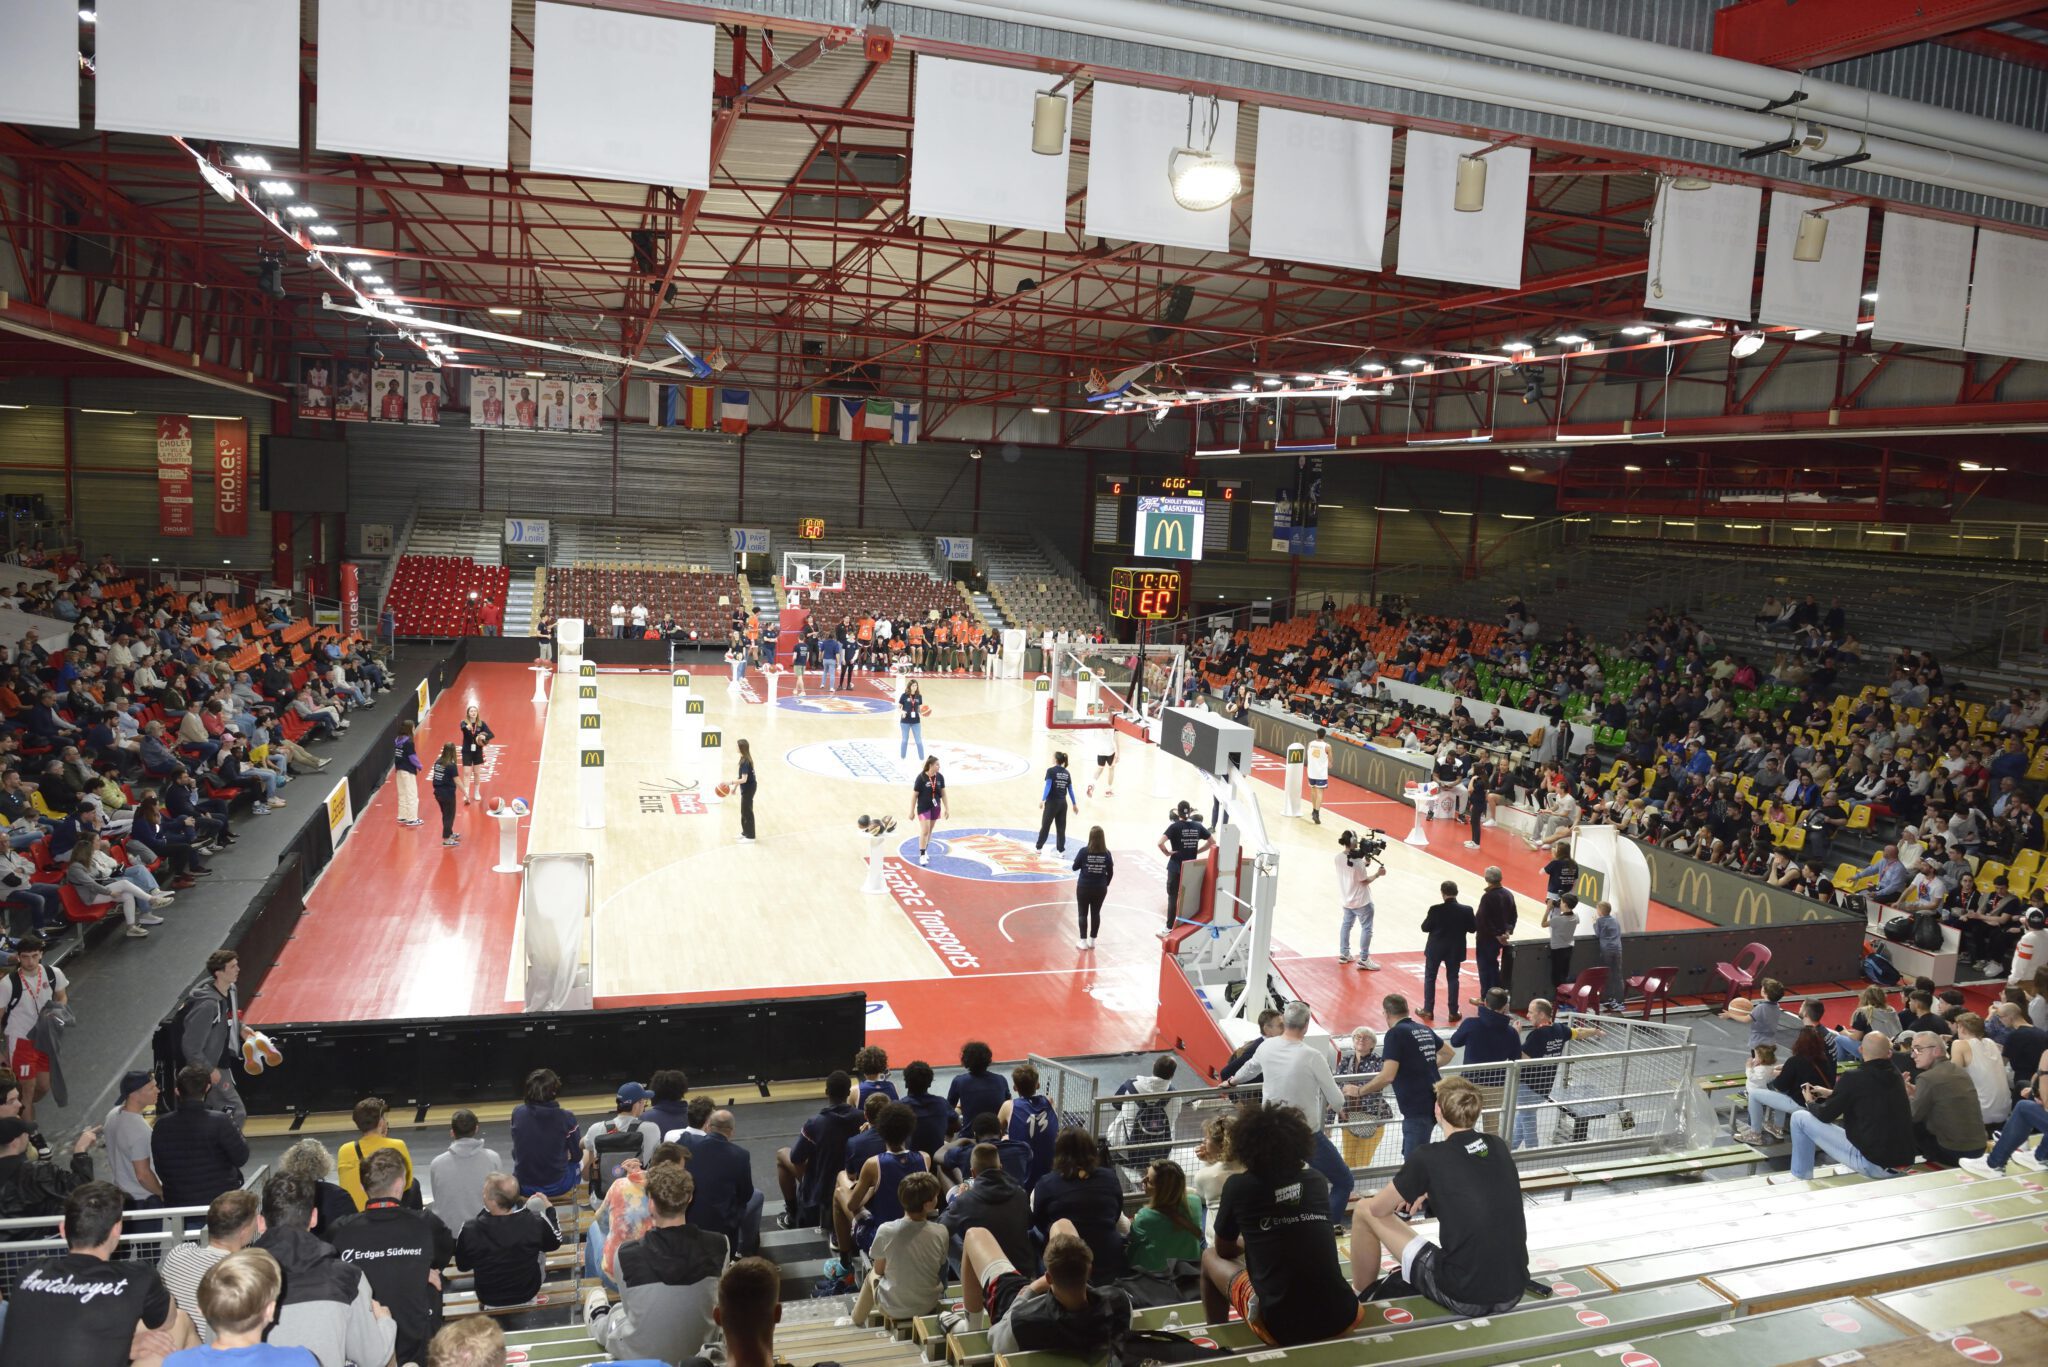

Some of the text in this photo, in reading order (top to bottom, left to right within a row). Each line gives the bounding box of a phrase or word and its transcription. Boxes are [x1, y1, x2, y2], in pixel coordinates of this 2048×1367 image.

[1164, 505, 1204, 513] BASKETBALL
[912, 909, 981, 968] Transports
[1026, 1110, 1049, 1139] 13
[1273, 1215, 1300, 1226] Erdgas
[354, 1246, 422, 1261] Erdgas Südwest
